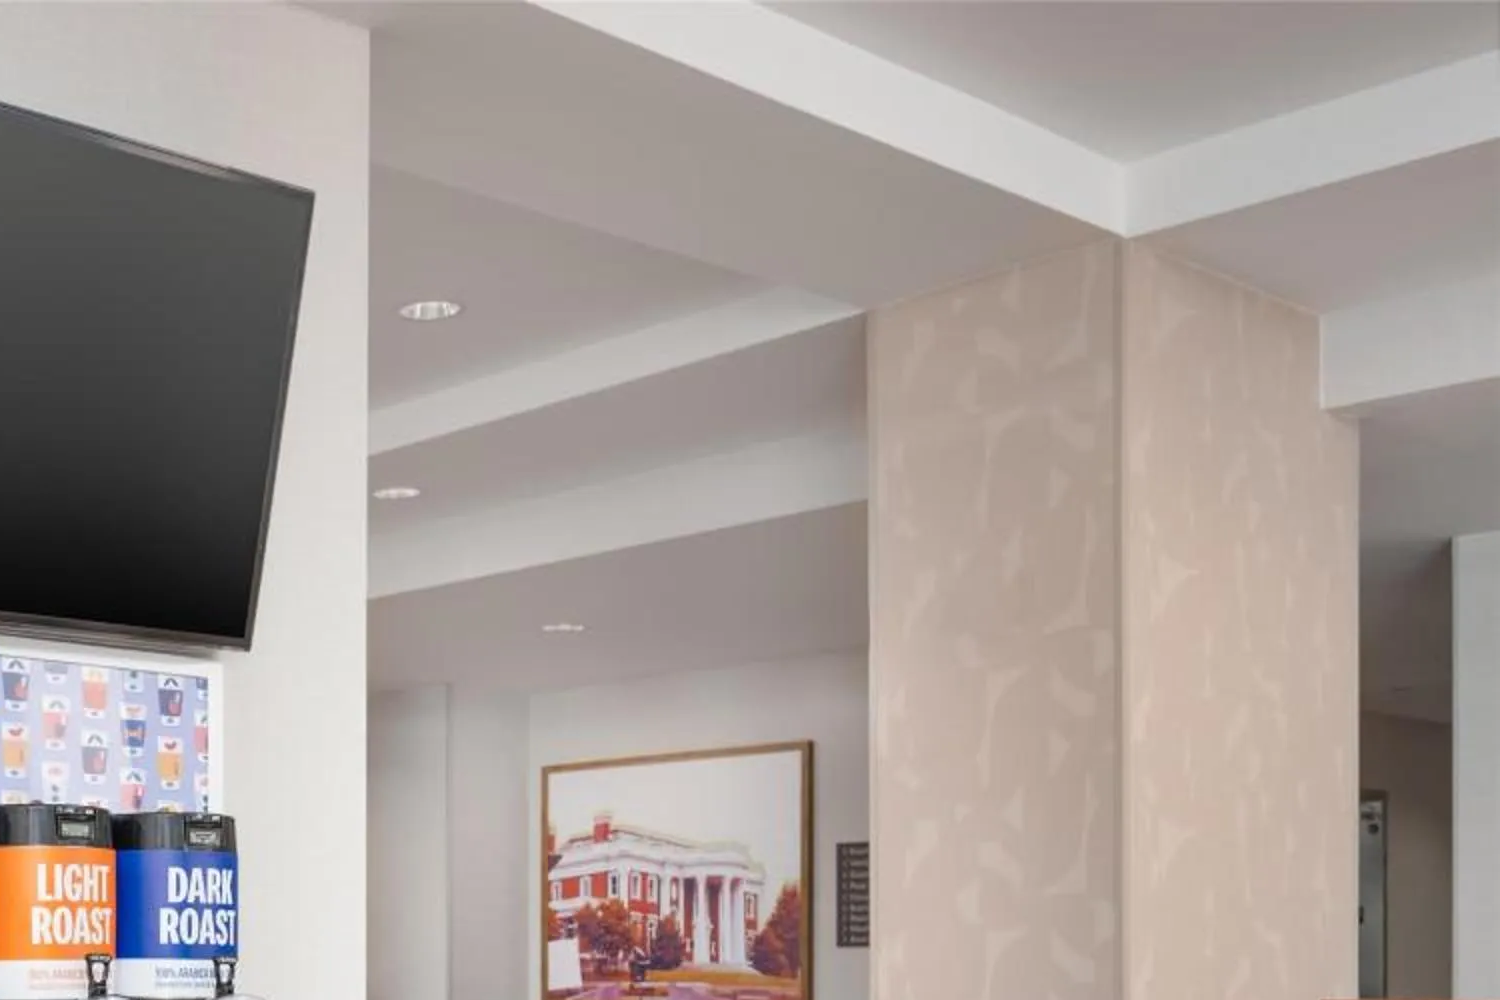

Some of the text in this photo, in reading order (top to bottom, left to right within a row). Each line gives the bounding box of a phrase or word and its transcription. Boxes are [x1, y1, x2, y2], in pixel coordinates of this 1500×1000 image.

[37, 863, 109, 901] LIGHT
[167, 867, 234, 905] DARK
[31, 907, 112, 945] ROAST
[159, 908, 236, 945] ROAST
